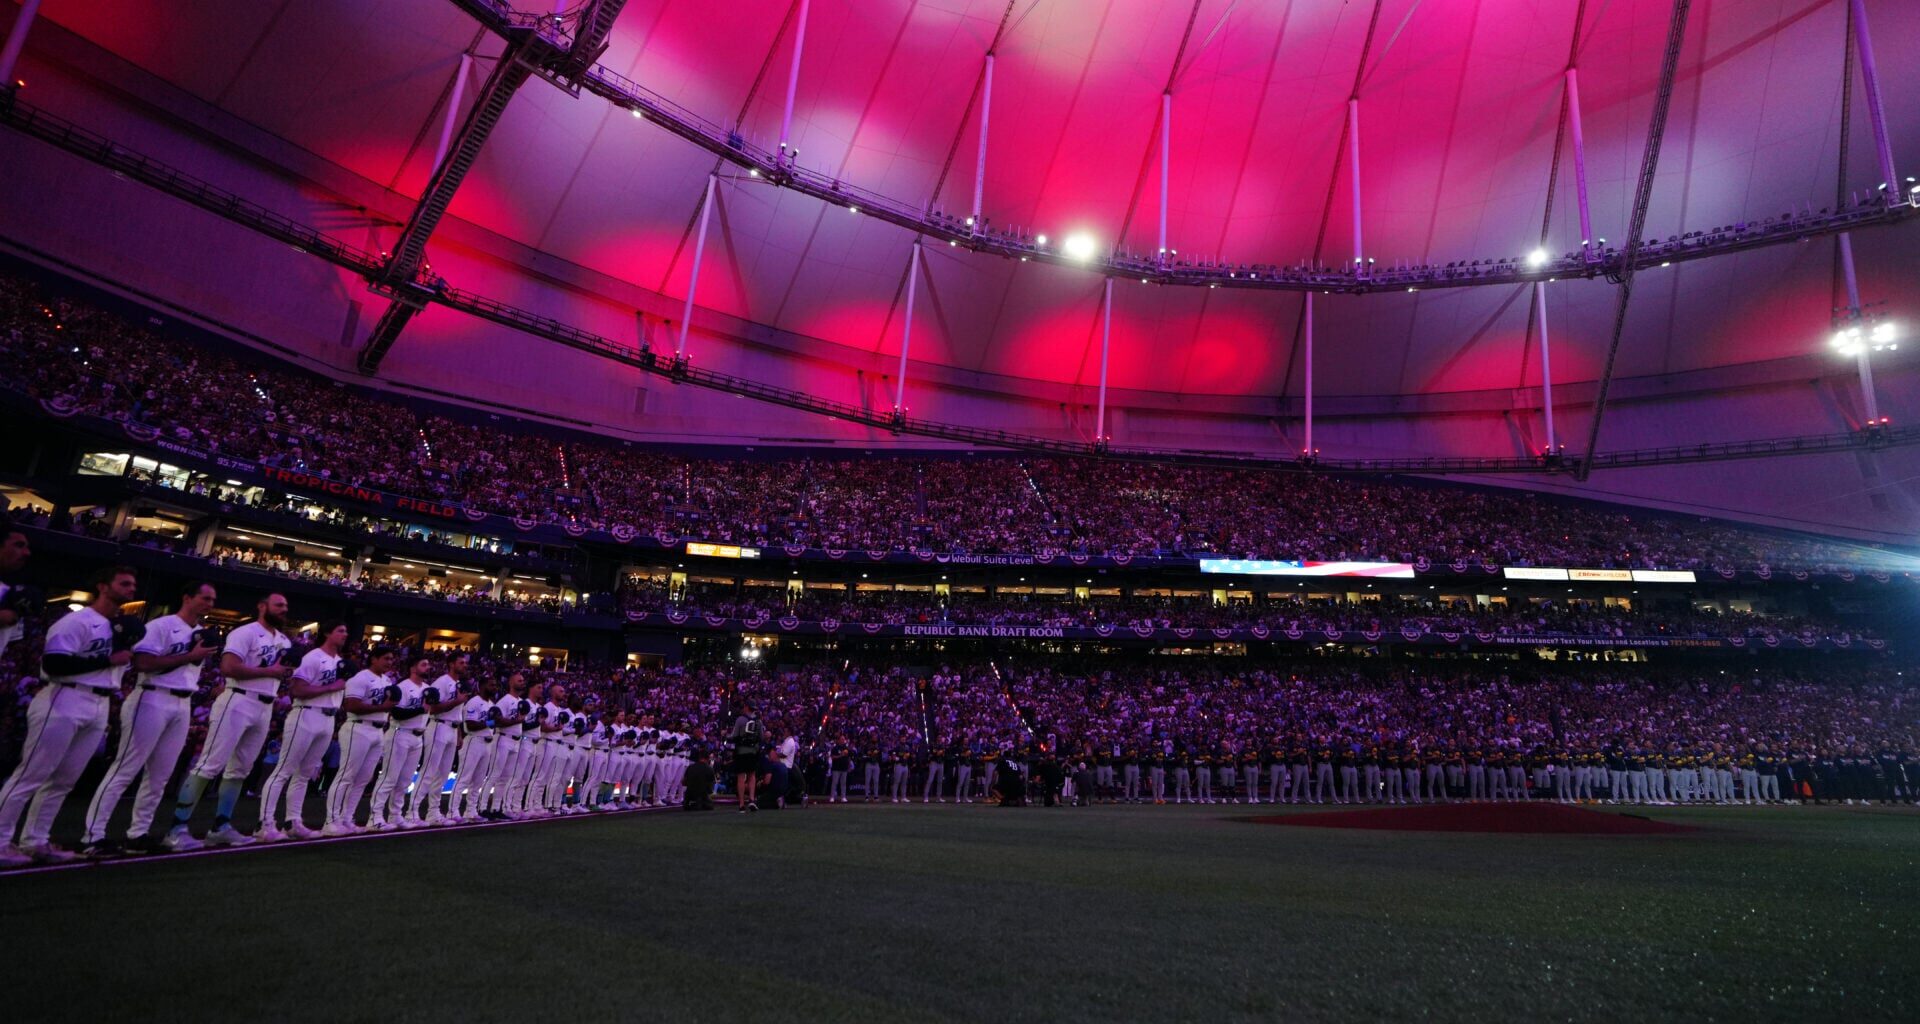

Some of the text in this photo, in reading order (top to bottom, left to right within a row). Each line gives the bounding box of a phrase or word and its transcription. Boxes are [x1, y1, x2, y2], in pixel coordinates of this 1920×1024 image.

[264, 467, 456, 518] TROPICANA FIELD
[951, 554, 1034, 565] Webull Suite Level
[904, 626, 1064, 637] REPUBLIC BANK DRAFT ROOM
[1516, 637, 1558, 645] Assistance?
[1629, 638, 1660, 646] Location
